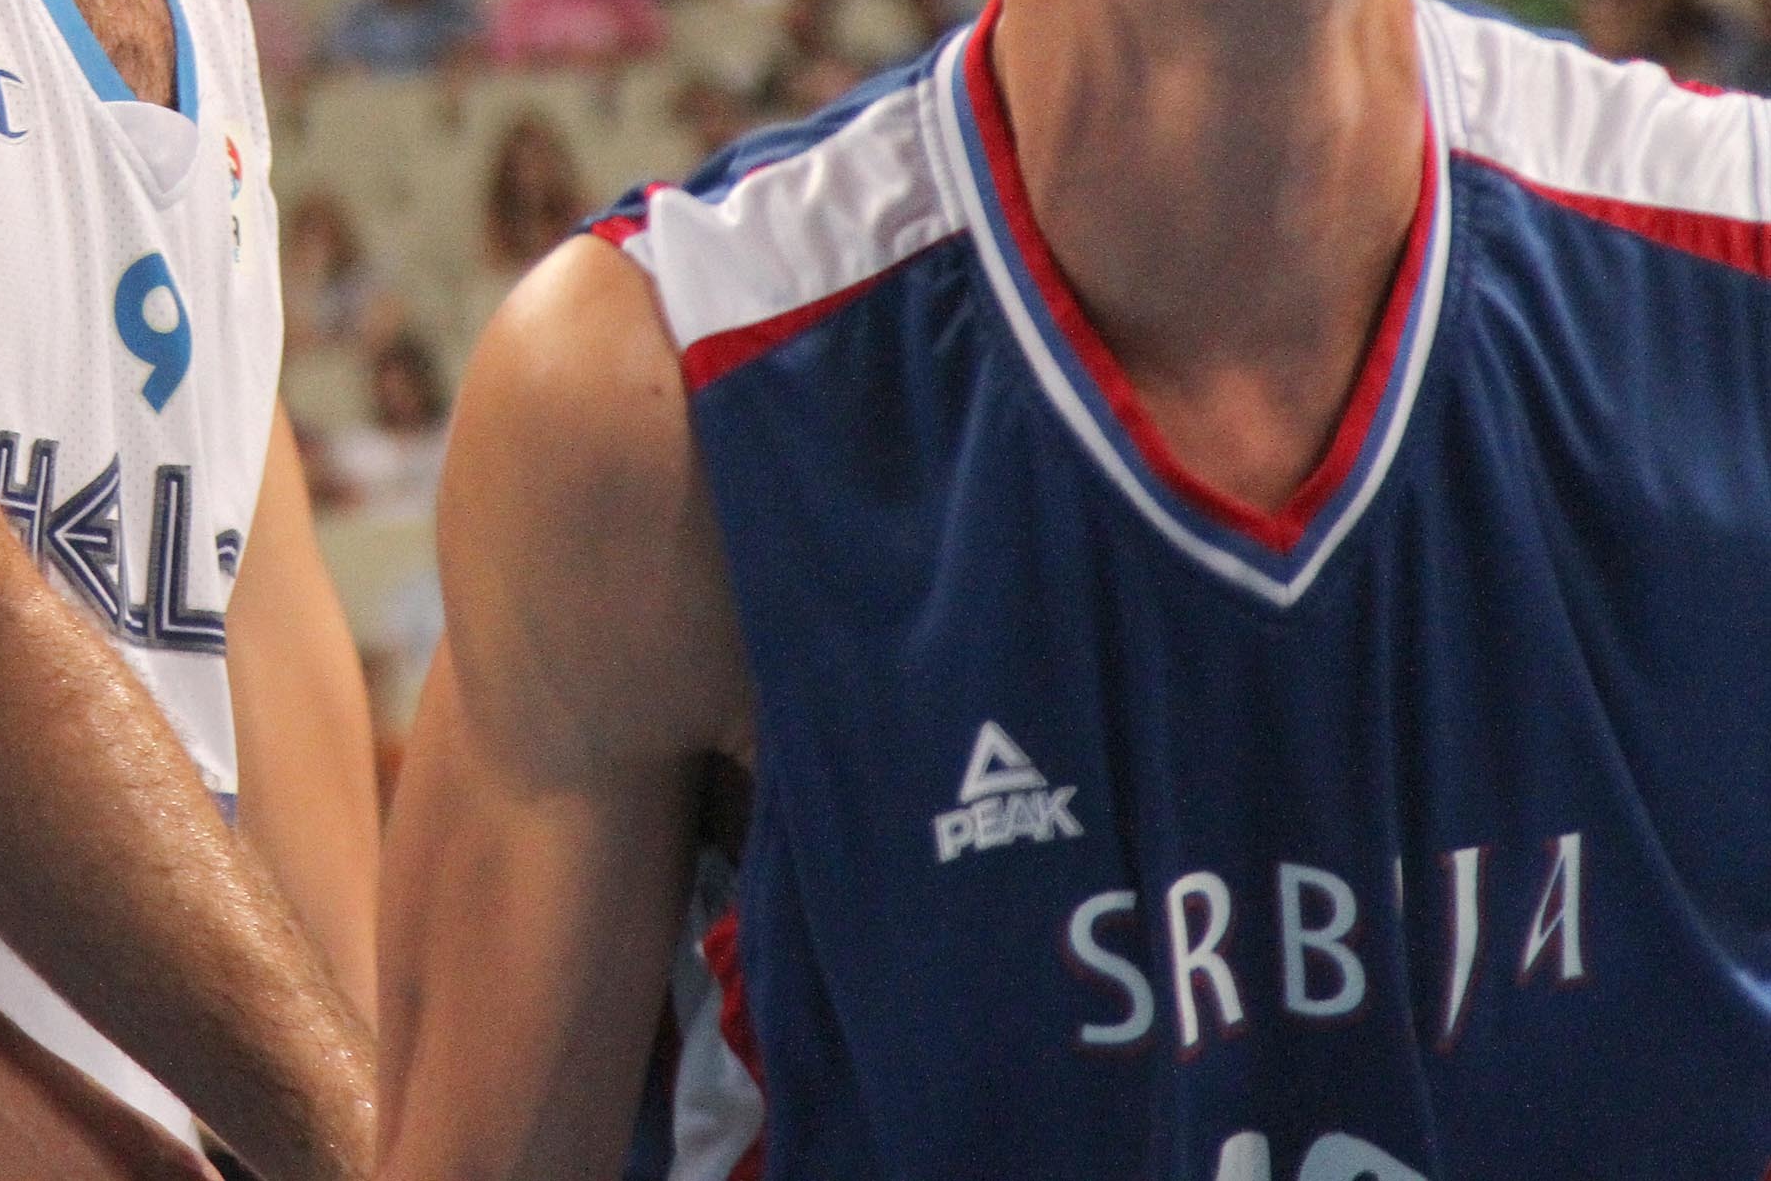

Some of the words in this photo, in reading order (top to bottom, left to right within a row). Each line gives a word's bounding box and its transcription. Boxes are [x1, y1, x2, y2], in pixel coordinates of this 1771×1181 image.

[114, 252, 192, 413] 9
[934, 785, 1085, 863] PEAK
[1061, 831, 1587, 1051] SRBJA
